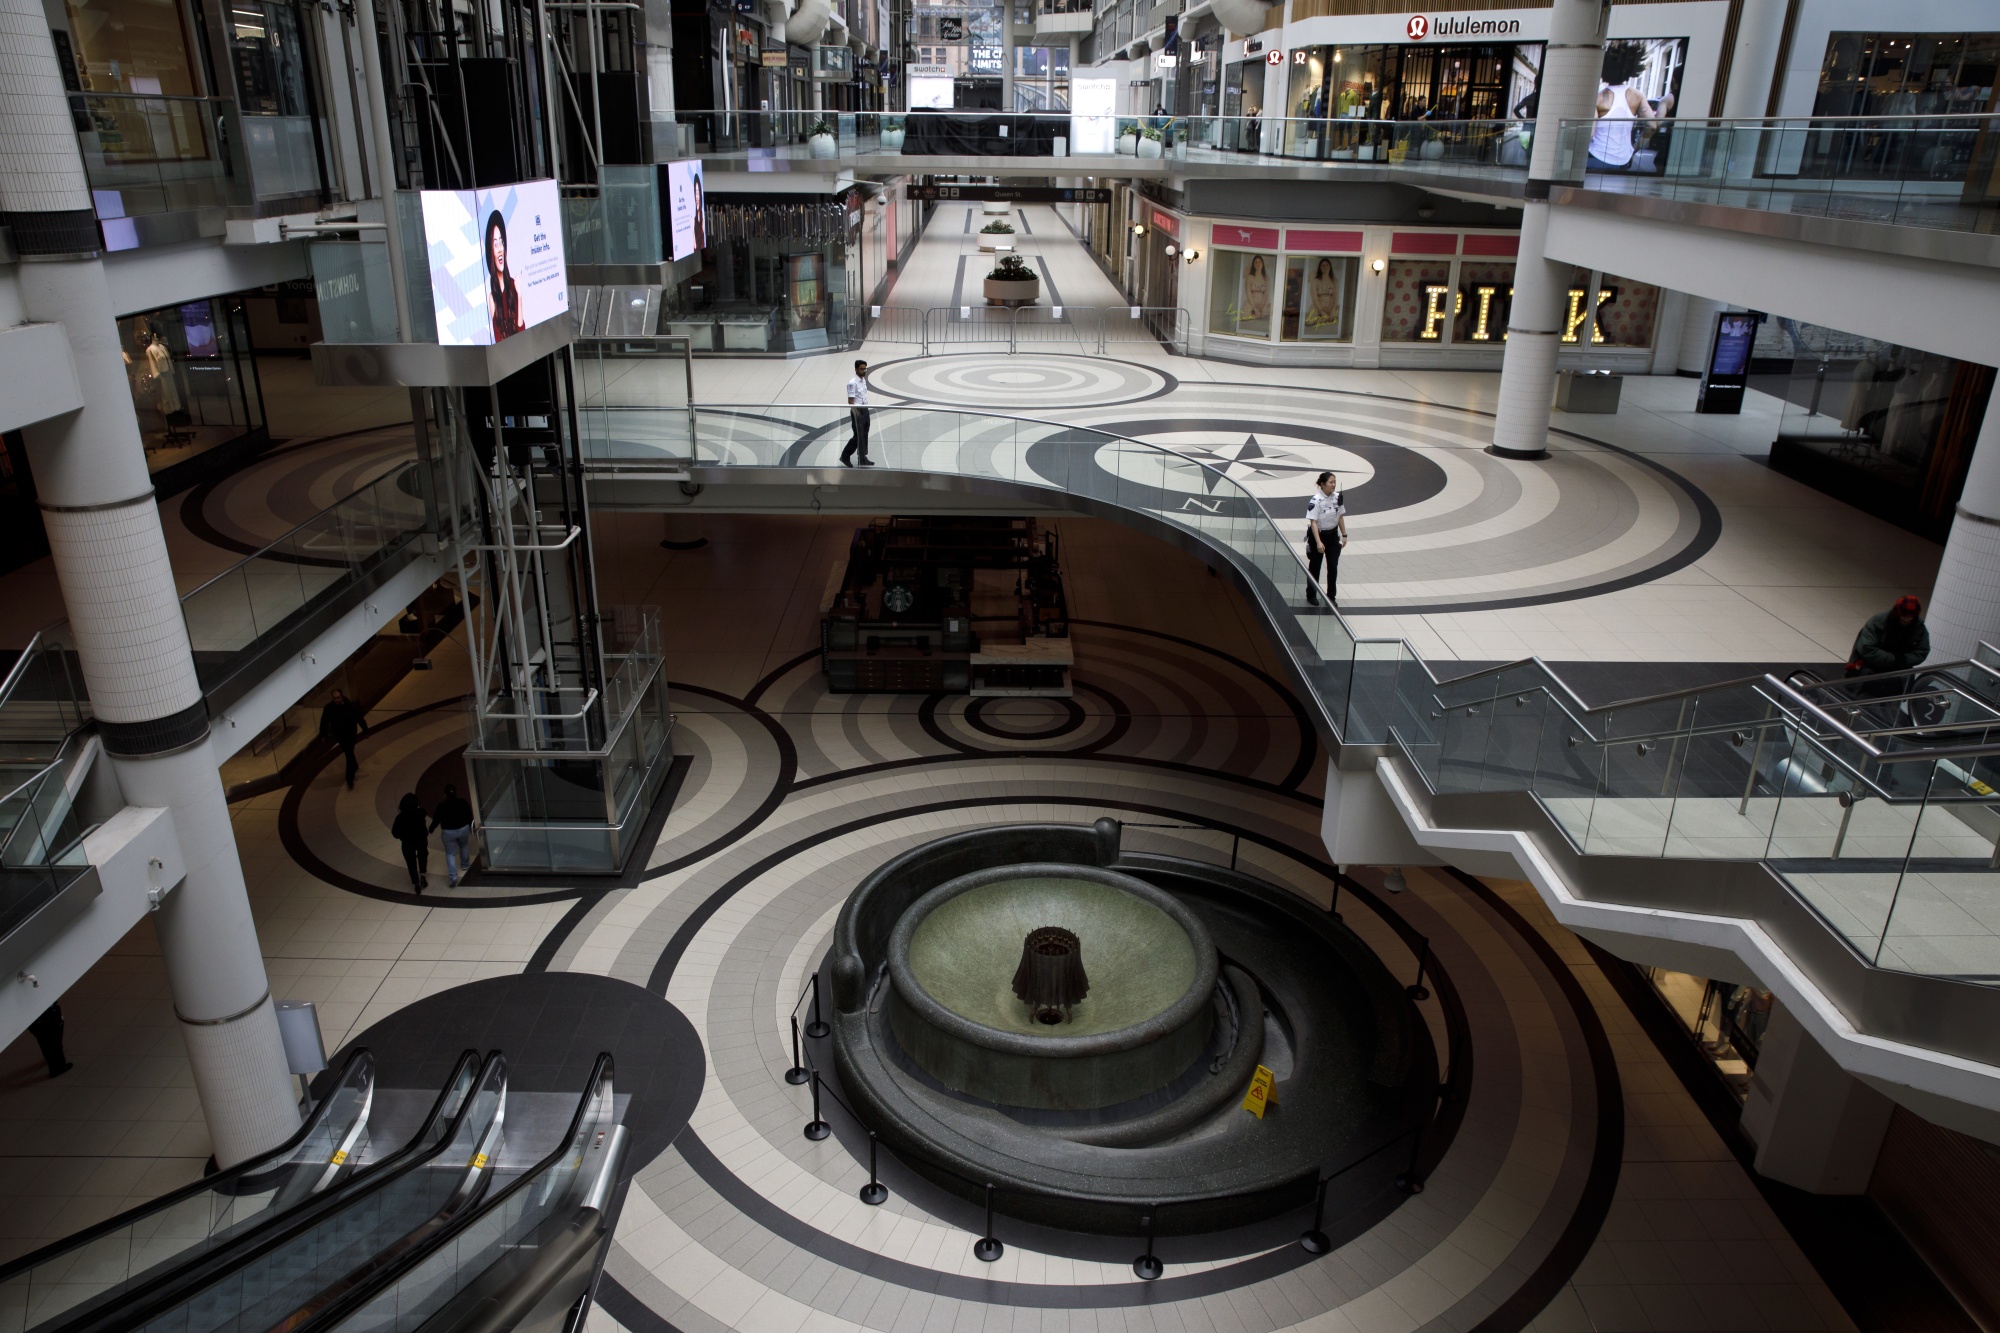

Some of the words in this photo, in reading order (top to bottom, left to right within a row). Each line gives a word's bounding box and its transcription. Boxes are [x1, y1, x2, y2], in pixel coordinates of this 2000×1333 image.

[1434, 16, 1519, 35] lululemon
[973, 49, 991, 59] THE
[285, 280, 316, 292] Yong
[1420, 284, 1613, 343] PIK
[1175, 497, 1228, 514] N
[1924, 702, 1935, 721] 2
